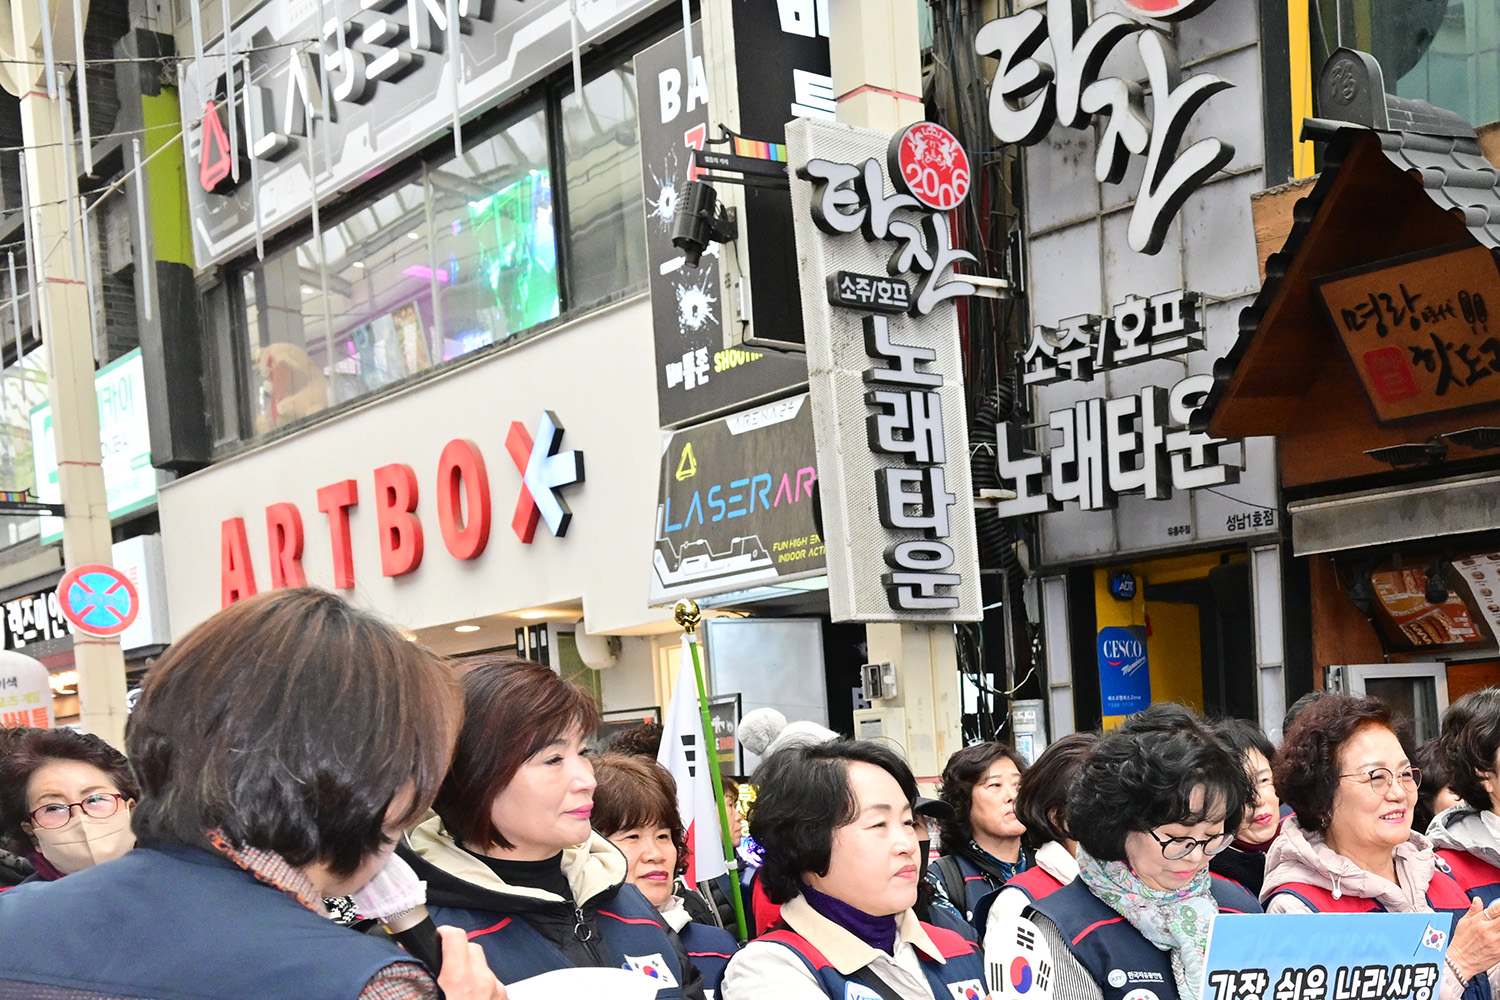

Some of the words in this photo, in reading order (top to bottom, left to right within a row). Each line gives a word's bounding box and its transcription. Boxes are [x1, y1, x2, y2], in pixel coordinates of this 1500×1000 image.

[905, 163, 969, 207] 2006
[839, 274, 909, 308] 소주/호프
[1340, 283, 1422, 338] 명랑
[1022, 288, 1192, 385] 소주/호프
[866, 315, 961, 611] 노래타운
[995, 373, 1228, 519] 노래타운
[220, 410, 586, 609] ARTBOX
[1225, 509, 1275, 532] 성남1호점
[772, 540, 788, 552] FUN
[788, 536, 809, 550] HIGH
[777, 549, 807, 564] INDOOR
[1118, 580, 1134, 593] ADT
[1103, 639, 1143, 659] CESCO
